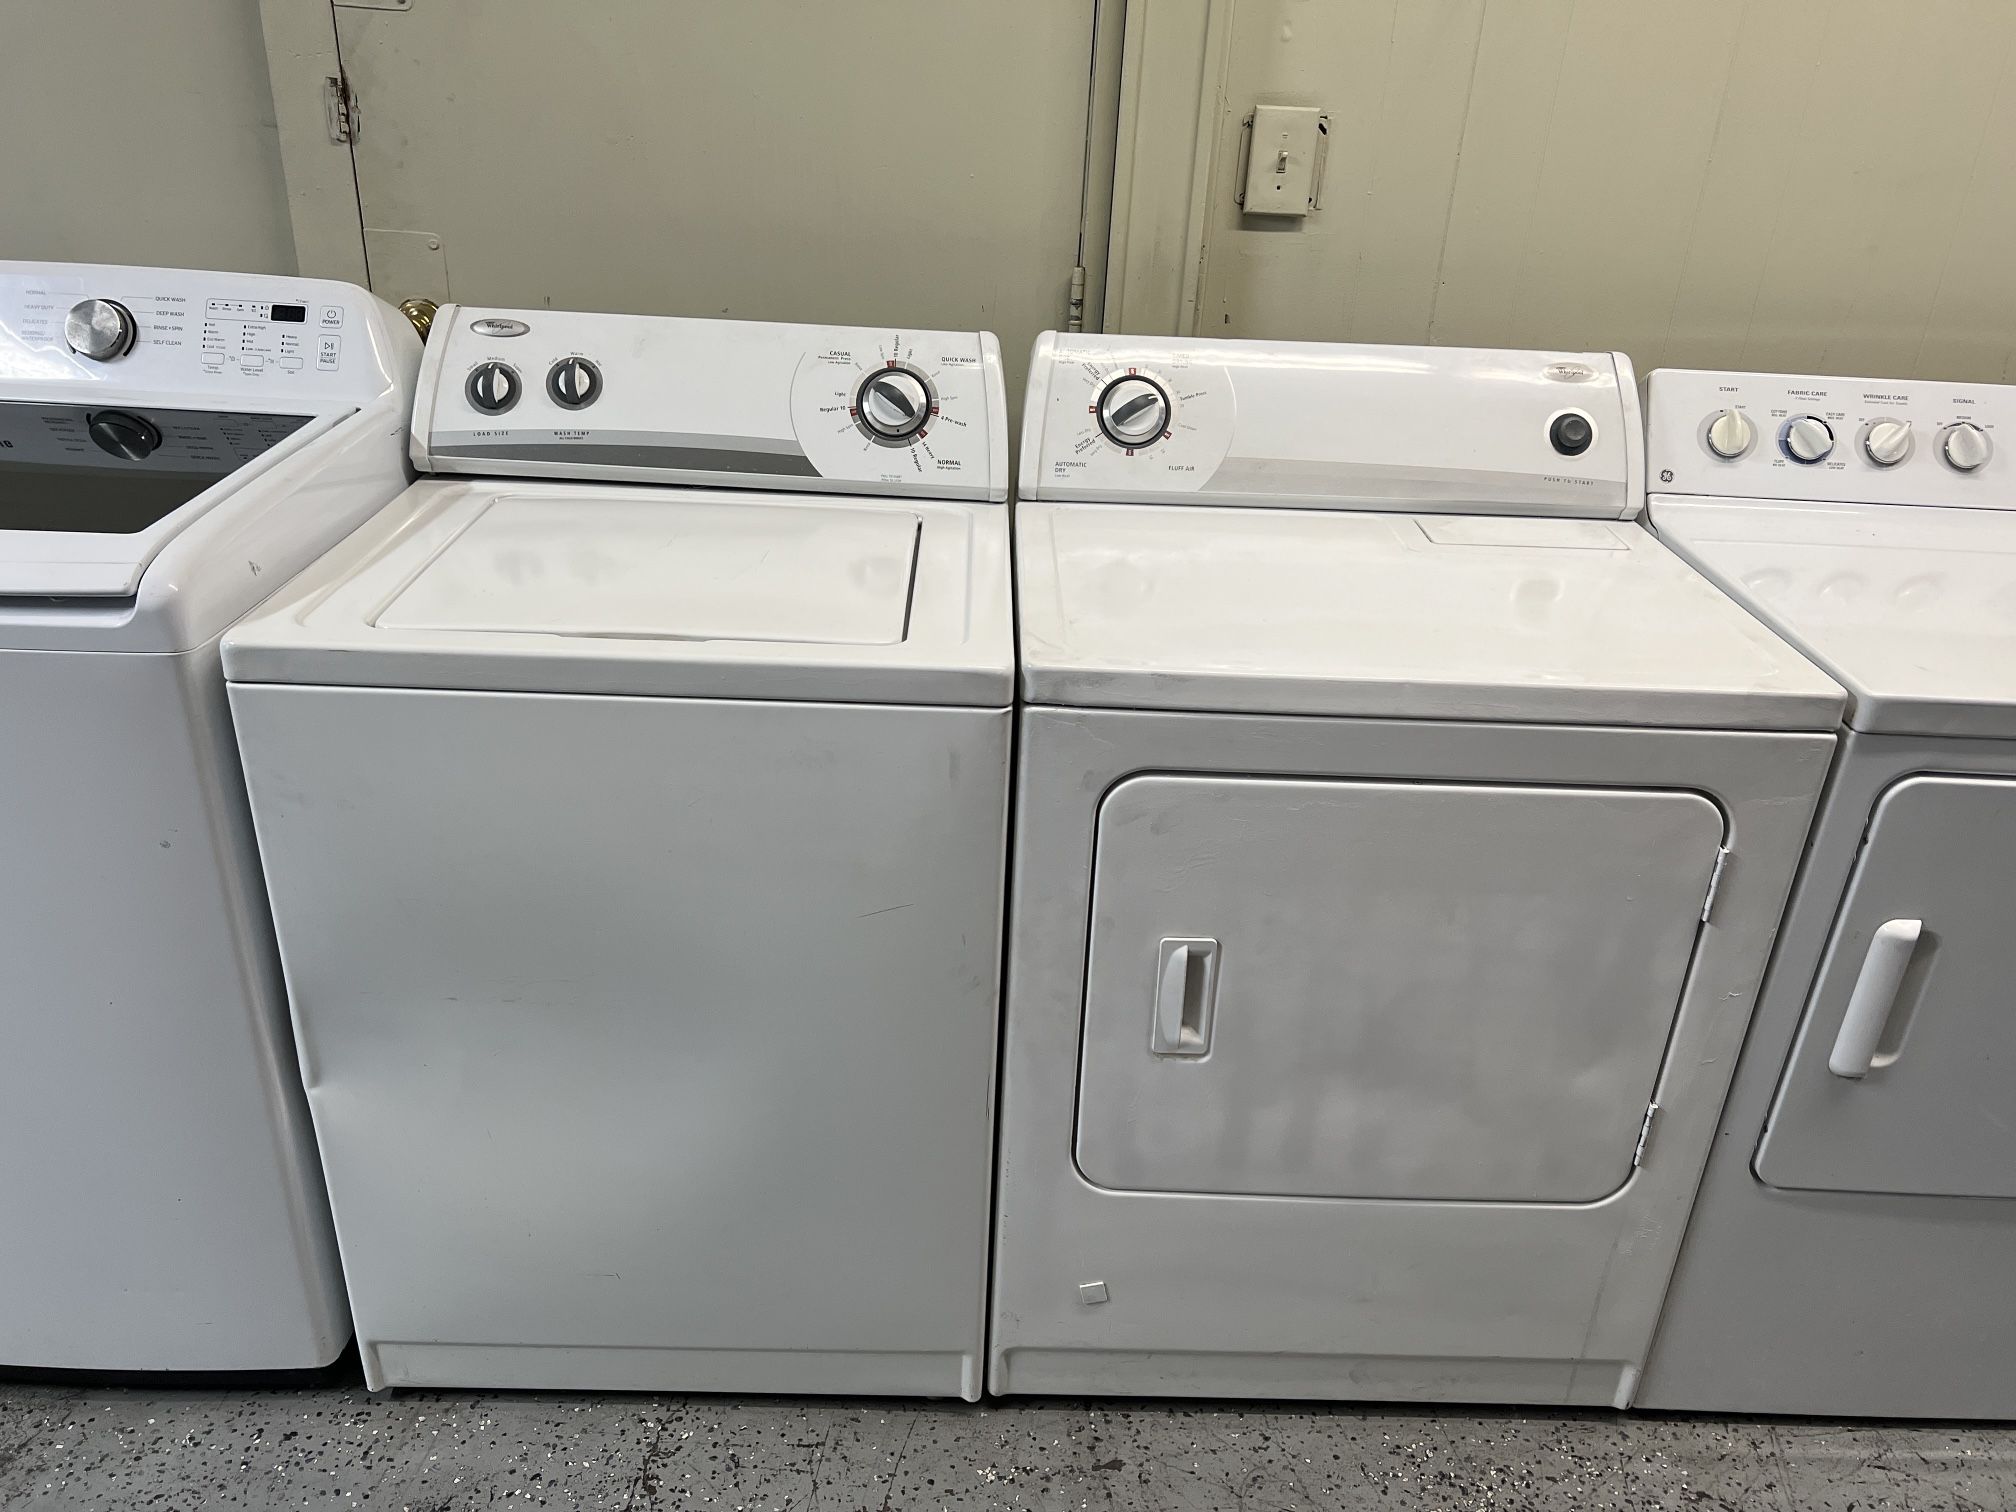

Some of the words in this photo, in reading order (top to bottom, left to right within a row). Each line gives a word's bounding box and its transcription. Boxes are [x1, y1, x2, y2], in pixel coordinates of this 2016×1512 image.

[485, 321, 514, 331] Whirlpool
[893, 334, 901, 352] Regular
[548, 357, 559, 365] Cold
[1087, 361, 1101, 376] Energy
[1081, 362, 1100, 381] Preferred
[945, 416, 967, 428] Pre-wash
[1074, 437, 1091, 449] Energy
[1075, 439, 1096, 455] Preferred
[912, 453, 923, 472] Regular
